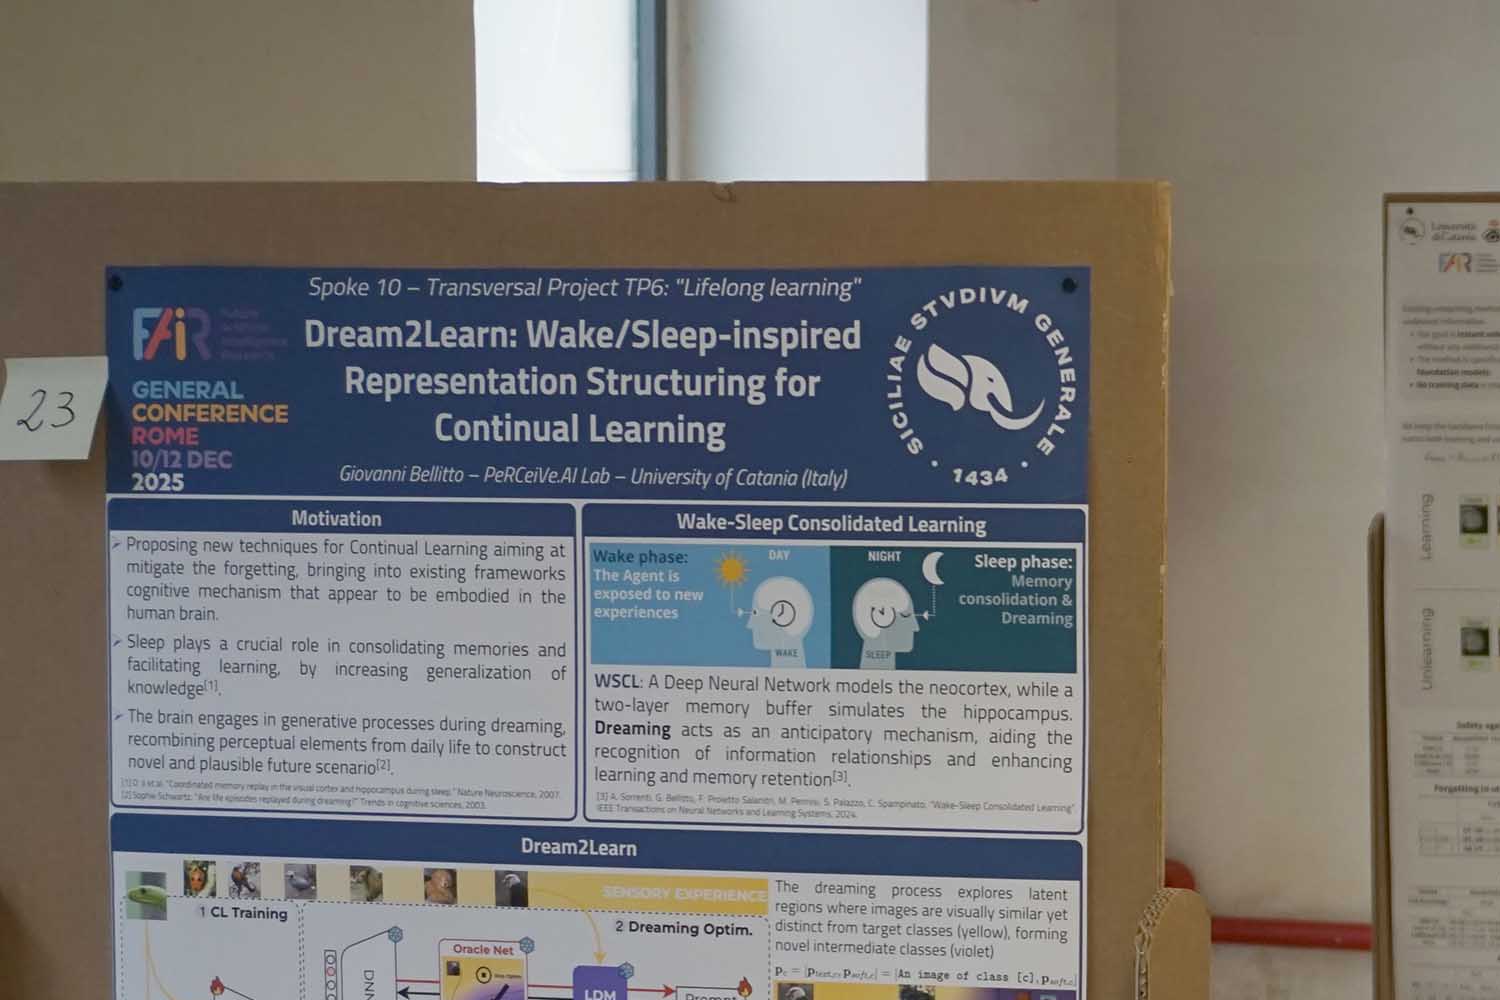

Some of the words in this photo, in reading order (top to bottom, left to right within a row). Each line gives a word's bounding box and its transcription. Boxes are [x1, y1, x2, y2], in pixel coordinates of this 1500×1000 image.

[308, 276, 370, 301] Spoke
[377, 278, 402, 297] 10
[427, 277, 543, 297] Transversal
[547, 277, 619, 301] Project
[624, 278, 669, 297] TP6:
[305, 319, 517, 348] Dream2Learn:
[526, 319, 861, 356] Wake/Sleep-inspired
[132, 380, 244, 400] GENERAL
[345, 365, 577, 403] Representation
[586, 366, 767, 405] Structuring
[774, 366, 821, 397] for
[16, 387, 76, 432] 23
[132, 403, 289, 423] CONFERENCE
[132, 426, 199, 446] ROME
[435, 412, 579, 442] Continual
[590, 413, 726, 452] Learning
[132, 449, 182, 473] 10/12
[187, 450, 233, 469] DEC
[132, 472, 184, 492] 2025
[339, 464, 407, 482] Giovanni
[409, 465, 464, 483] Bellitto
[483, 466, 578, 484] PeRCeiVe.AI
[580, 466, 611, 484] Lab
[631, 467, 712, 490] University
[715, 467, 734, 491] of
[736, 468, 799, 487] Catania
[801, 468, 848, 491] (Italy)
[953, 467, 1009, 487] 1434
[292, 509, 382, 527] Motivation
[676, 512, 784, 536] Wake-Sleep
[788, 514, 903, 532] Consolidated
[908, 515, 987, 538] Learning
[127, 536, 198, 557] Proposing
[203, 540, 234, 553] new
[239, 538, 318, 557] techniques
[323, 538, 345, 555] for
[350, 539, 418, 556] Continual
[424, 541, 489, 561] Learning
[493, 541, 545, 562] aiming
[550, 543, 566, 558] at
[592, 549, 635, 564] Wake
[639, 549, 689, 568] phase:
[768, 549, 791, 561] DAY
[867, 550, 902, 562] NIGHT
[975, 553, 1017, 572] Sleep
[1021, 554, 1073, 573] phase:
[521, 837, 637, 857] Dream2Learn
[602, 886, 671, 899] SENSORY
[674, 887, 768, 904] EXPERIENCE
[200, 906, 205, 916] 1
[210, 906, 228, 918] CL
[231, 906, 288, 923] Training
[615, 920, 623, 932] 2
[628, 920, 699, 938] Dreaming
[703, 923, 753, 938] Optim.
[453, 943, 491, 955] Oracle
[493, 945, 514, 956] Net
